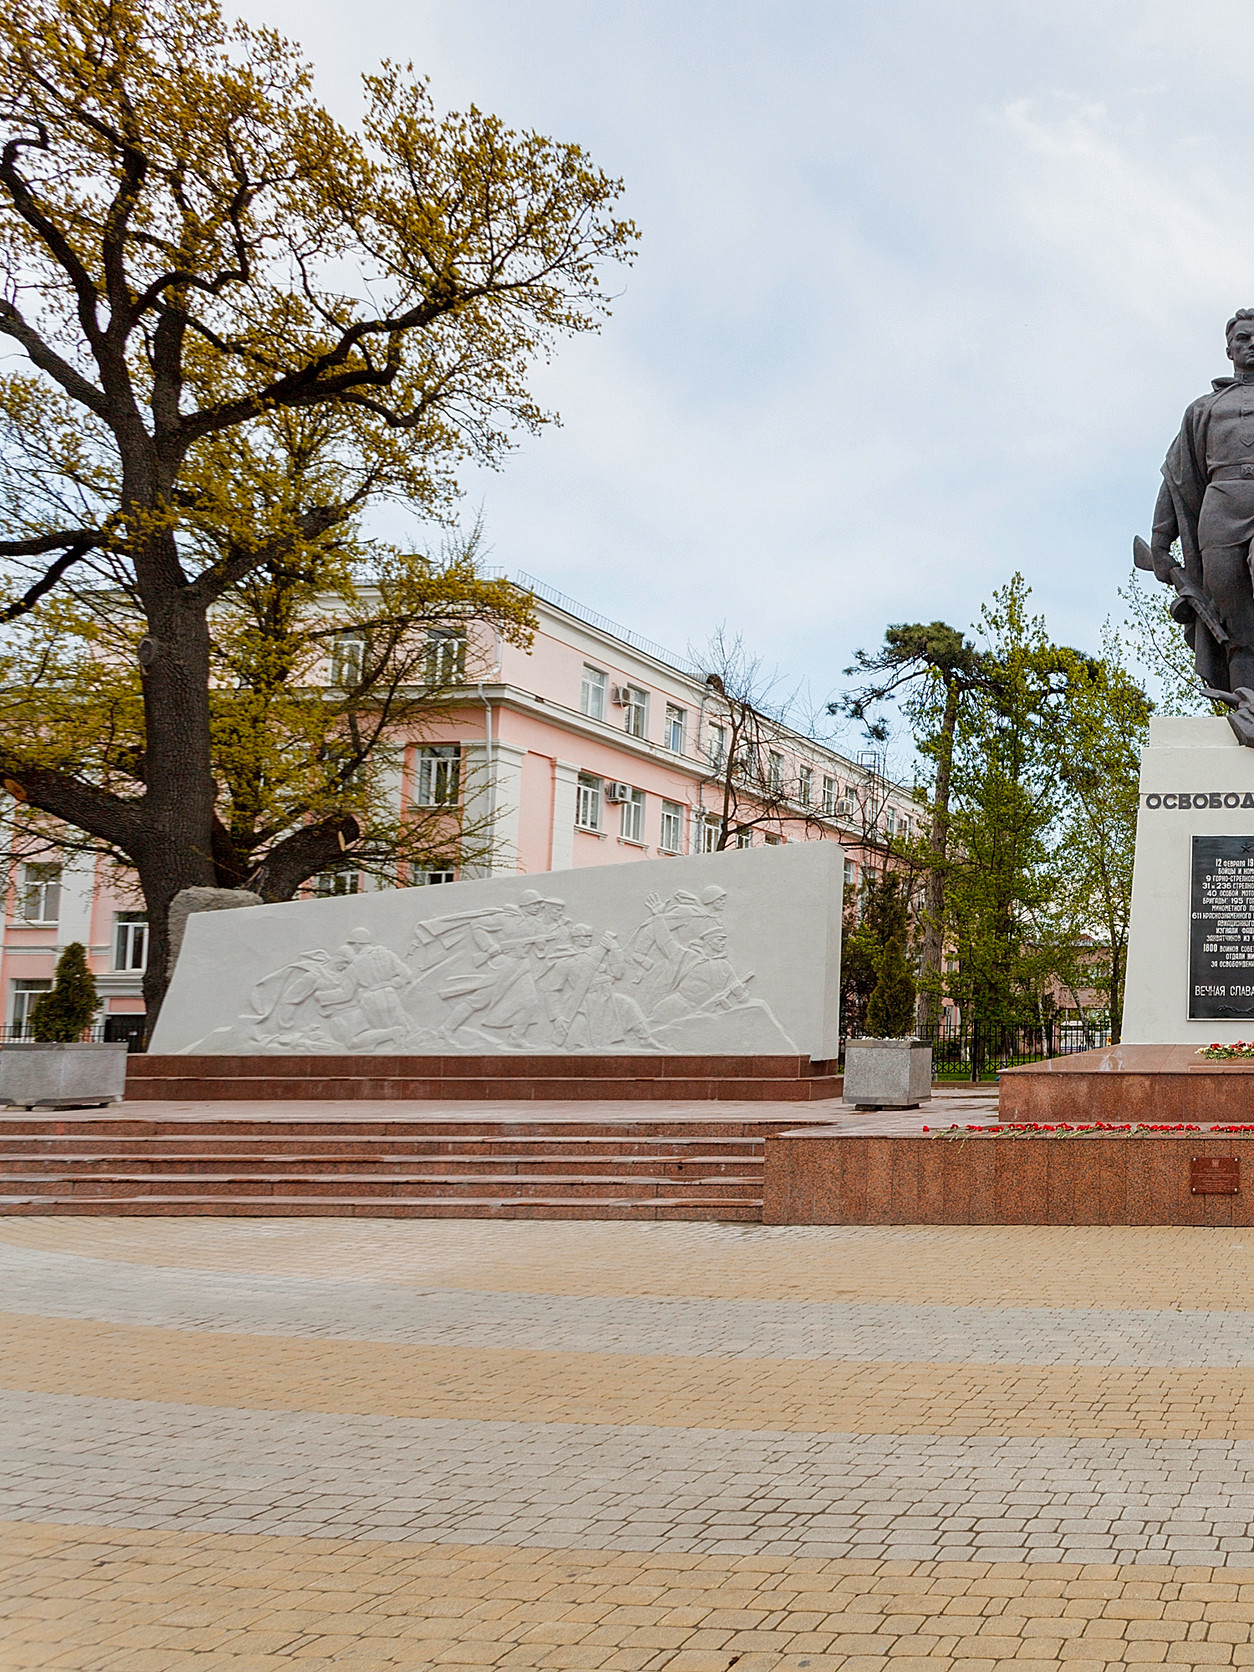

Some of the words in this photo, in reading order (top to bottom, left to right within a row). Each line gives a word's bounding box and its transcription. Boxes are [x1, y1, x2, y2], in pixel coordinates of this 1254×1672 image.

[1215, 858, 1222, 867] 12
[1203, 943, 1218, 953] 1800
[1194, 985, 1226, 996] ВЕЧНАЯ
